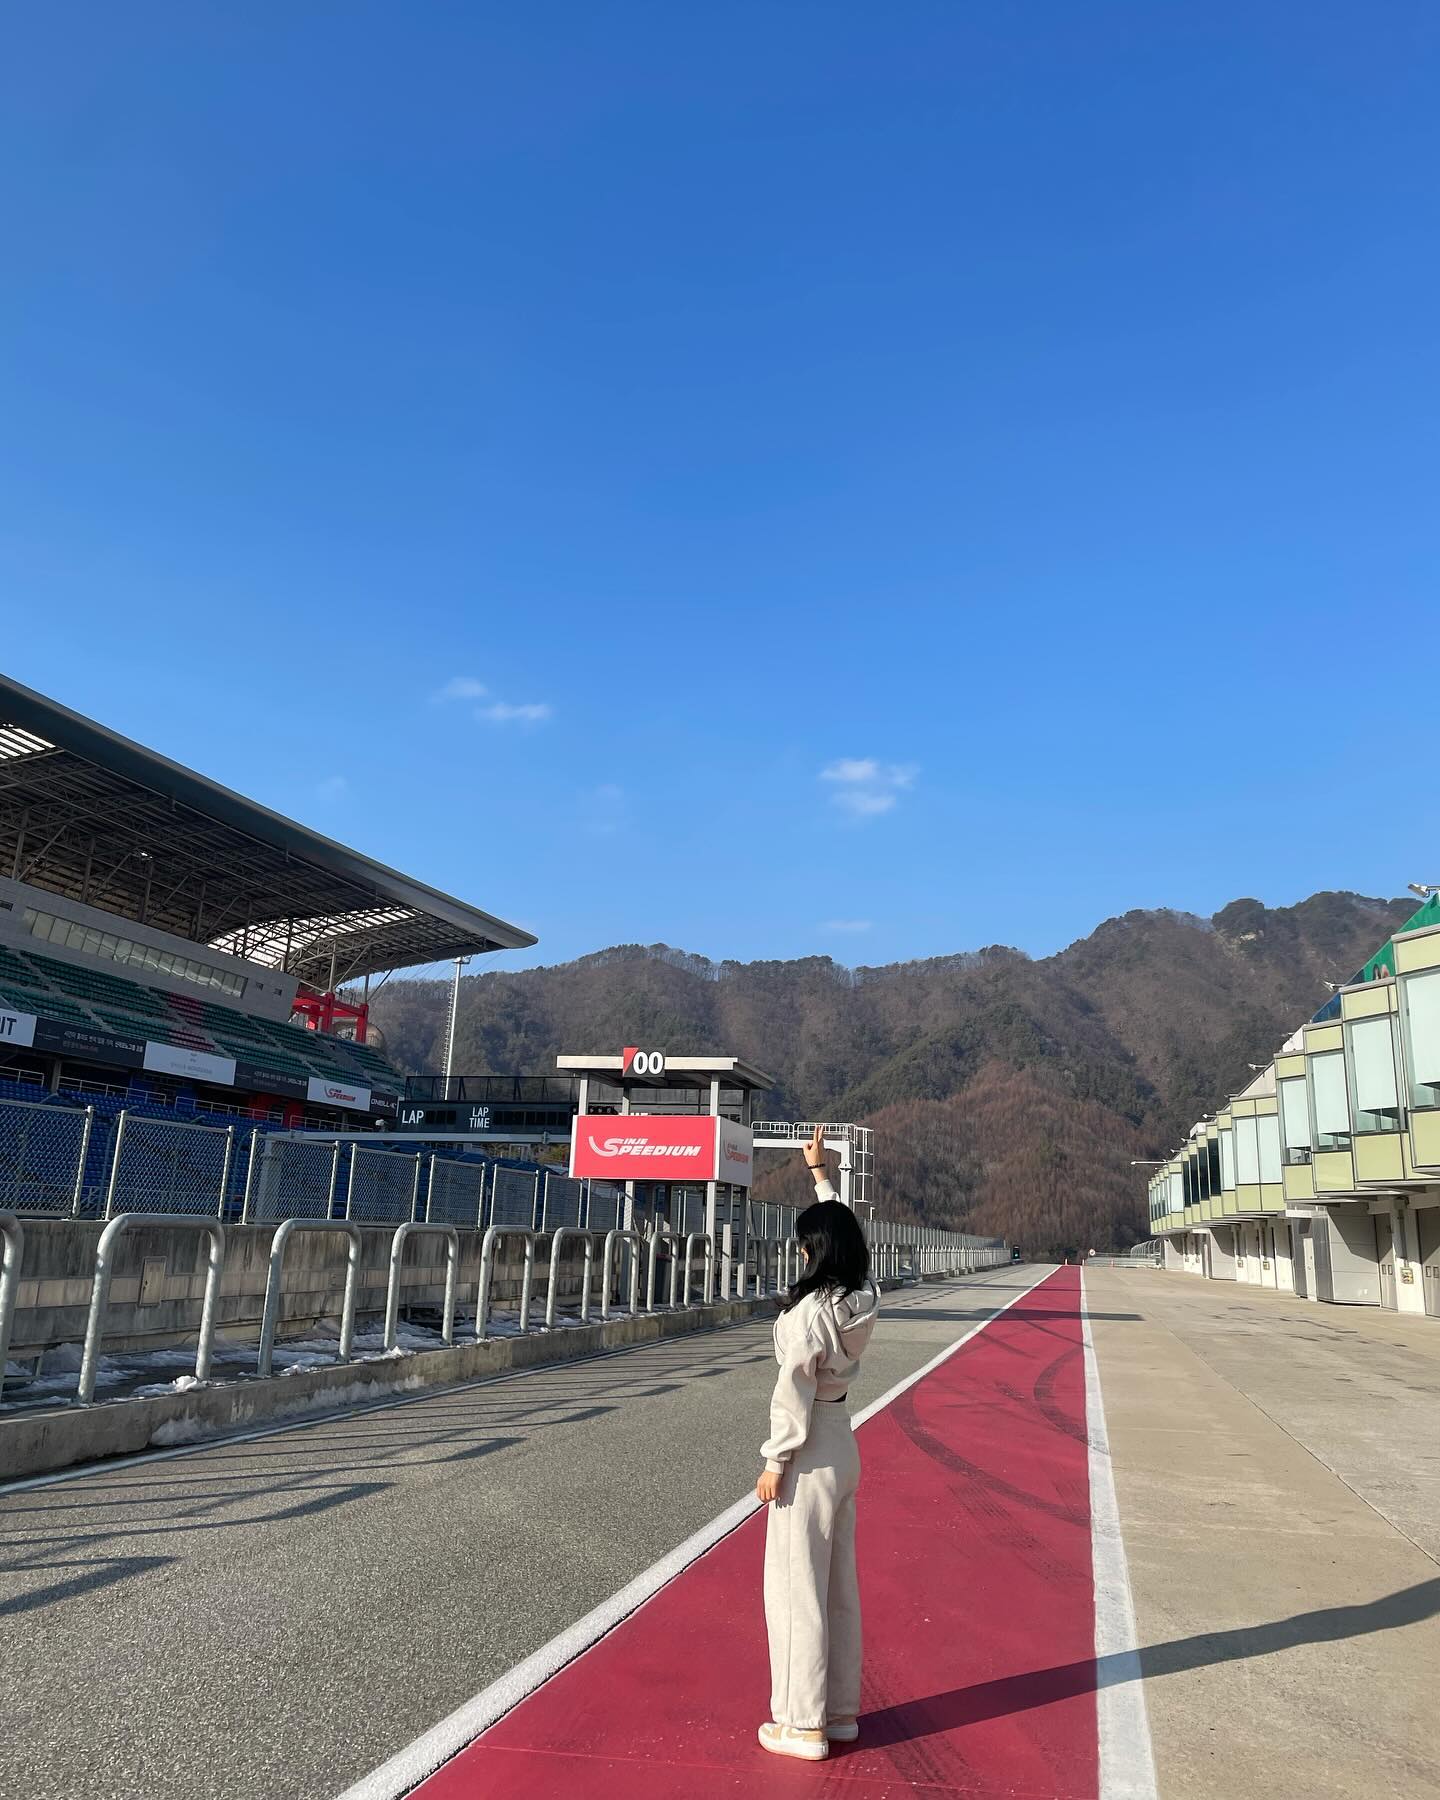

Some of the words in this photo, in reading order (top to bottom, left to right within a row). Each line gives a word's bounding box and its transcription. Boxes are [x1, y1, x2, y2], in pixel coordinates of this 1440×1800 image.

[633, 1051, 664, 1075] 00
[401, 1109, 425, 1124] LAP
[473, 1106, 489, 1117] LAP
[469, 1117, 490, 1128] TIME
[589, 1136, 702, 1157] SPEEDIUM
